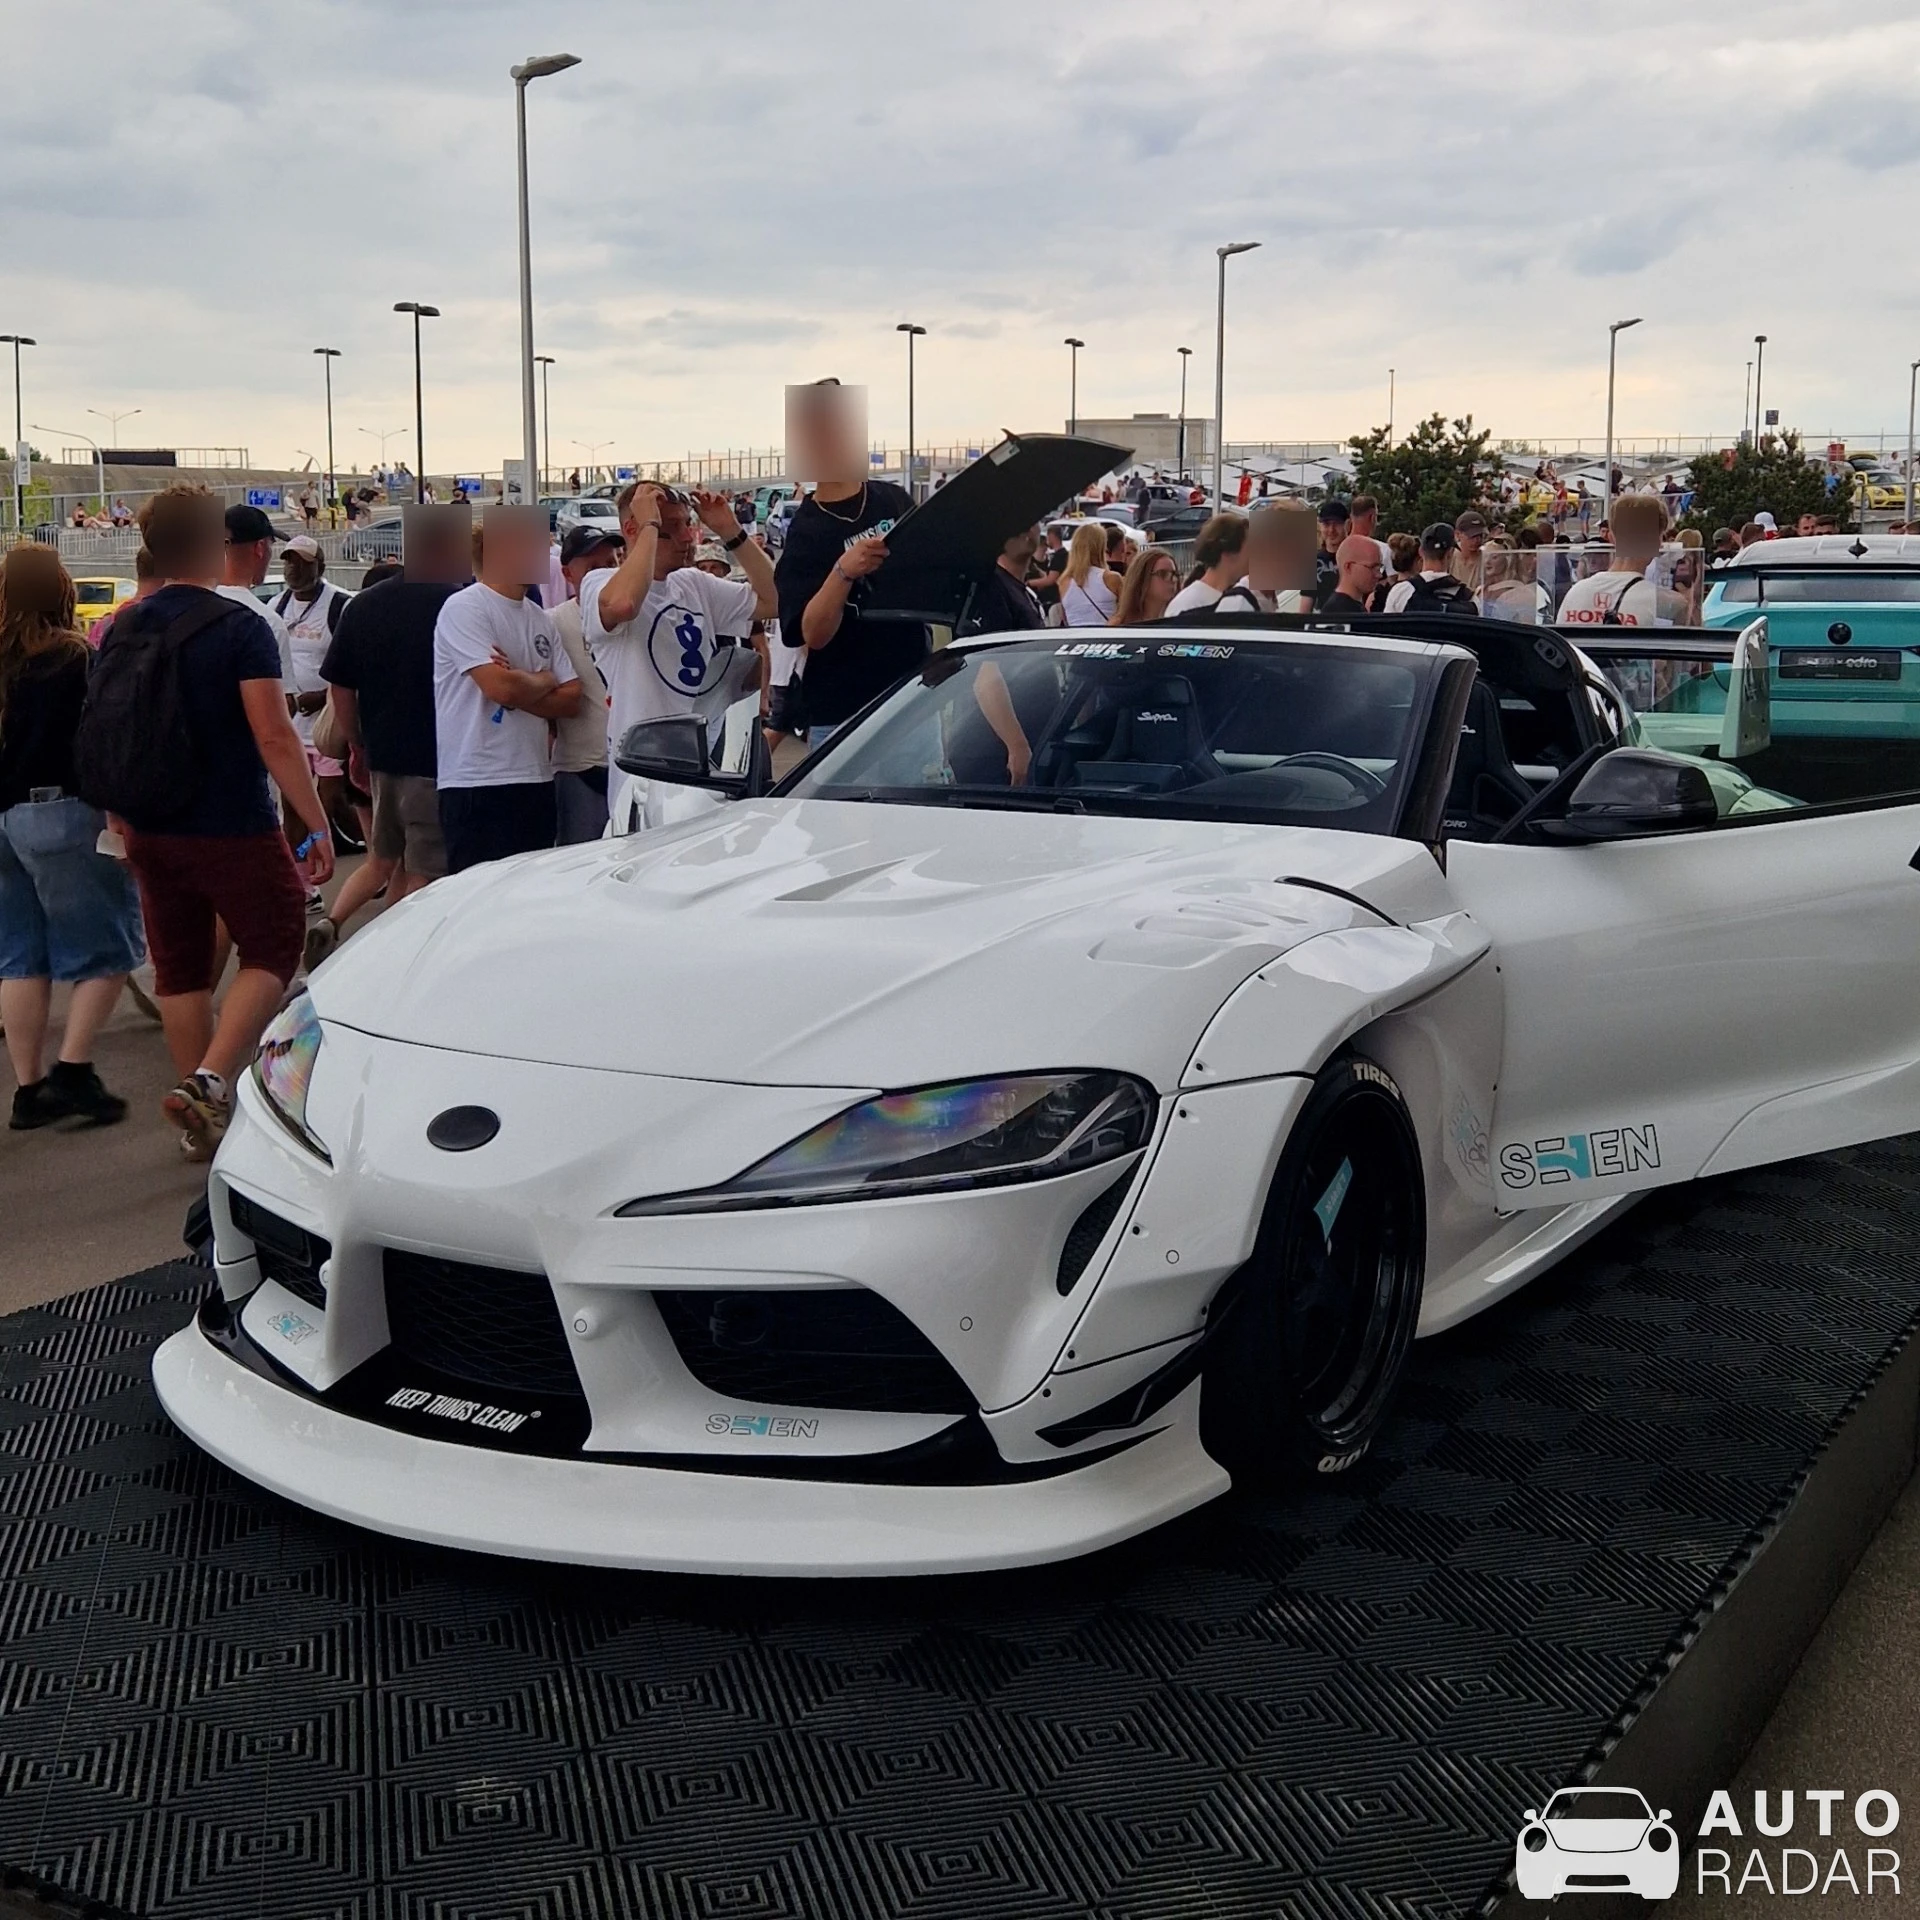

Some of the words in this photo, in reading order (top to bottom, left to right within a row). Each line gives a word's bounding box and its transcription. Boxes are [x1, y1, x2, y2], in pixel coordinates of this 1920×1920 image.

[1137, 711, 1178, 724] Supra
[385, 1388, 432, 1409] KEEP
[423, 1395, 482, 1421] THINGS
